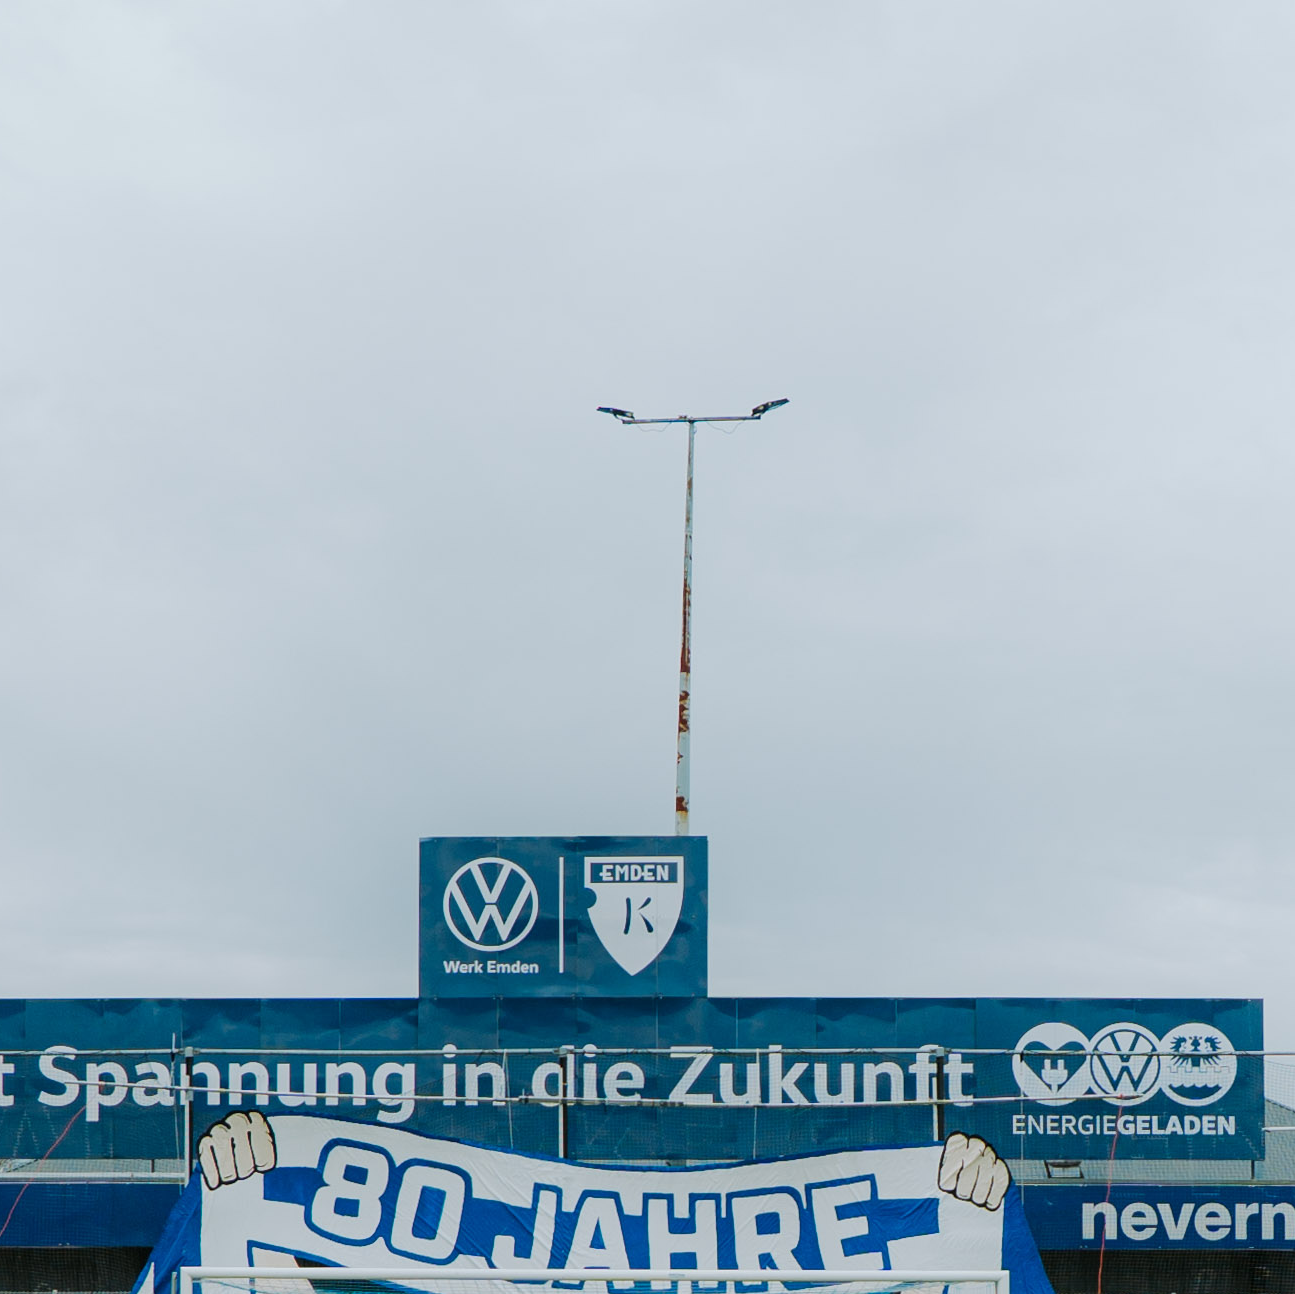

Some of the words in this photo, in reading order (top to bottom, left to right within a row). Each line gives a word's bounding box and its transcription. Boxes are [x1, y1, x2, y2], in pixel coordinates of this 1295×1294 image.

[599, 864, 669, 882] EMDEN
[624, 897, 654, 935] K
[443, 960, 484, 974] Werk
[486, 960, 540, 974] Emden
[37, 1045, 416, 1123] Spannung
[443, 1043, 506, 1107] in
[531, 1043, 646, 1108] die
[668, 1043, 975, 1108] Zukunft
[1011, 1114, 1236, 1136] ENERGIEGELADEN
[311, 1143, 466, 1260] 80
[492, 1180, 884, 1291] JAHRE
